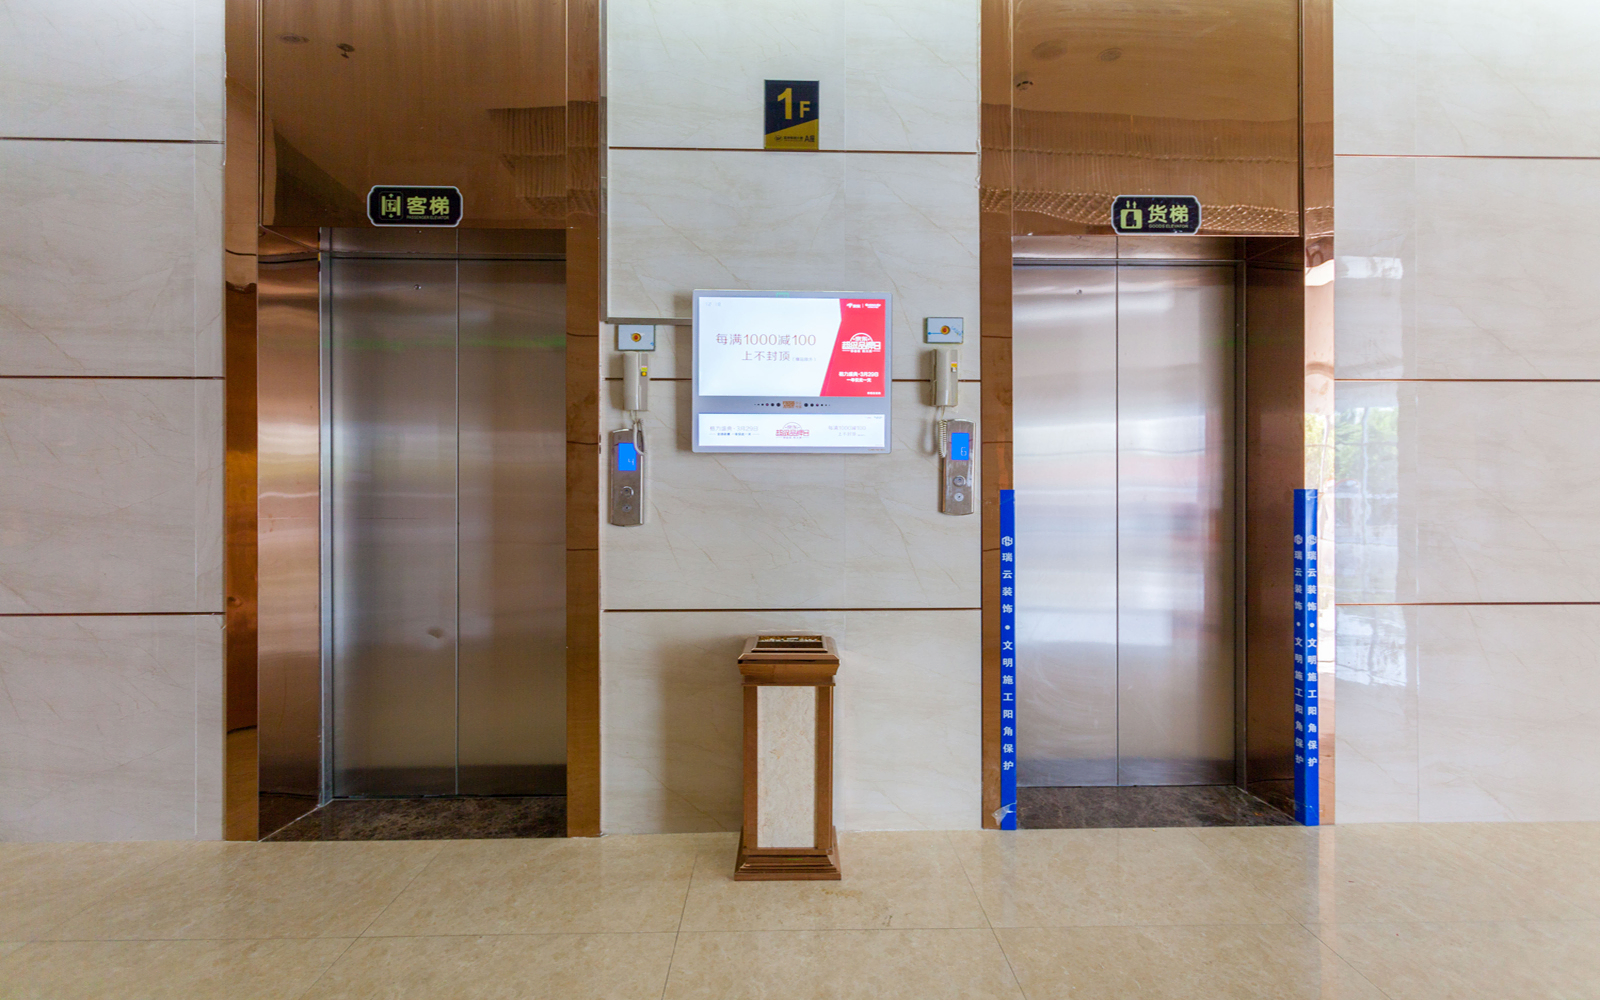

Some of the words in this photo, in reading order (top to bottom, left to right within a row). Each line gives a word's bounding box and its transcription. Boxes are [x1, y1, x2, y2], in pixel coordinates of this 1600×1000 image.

[406, 196, 450, 215] 客梯
[1147, 204, 1189, 224] 货梯
[716, 333, 817, 346] 每满1000减100
[742, 350, 790, 361] 上不封顶
